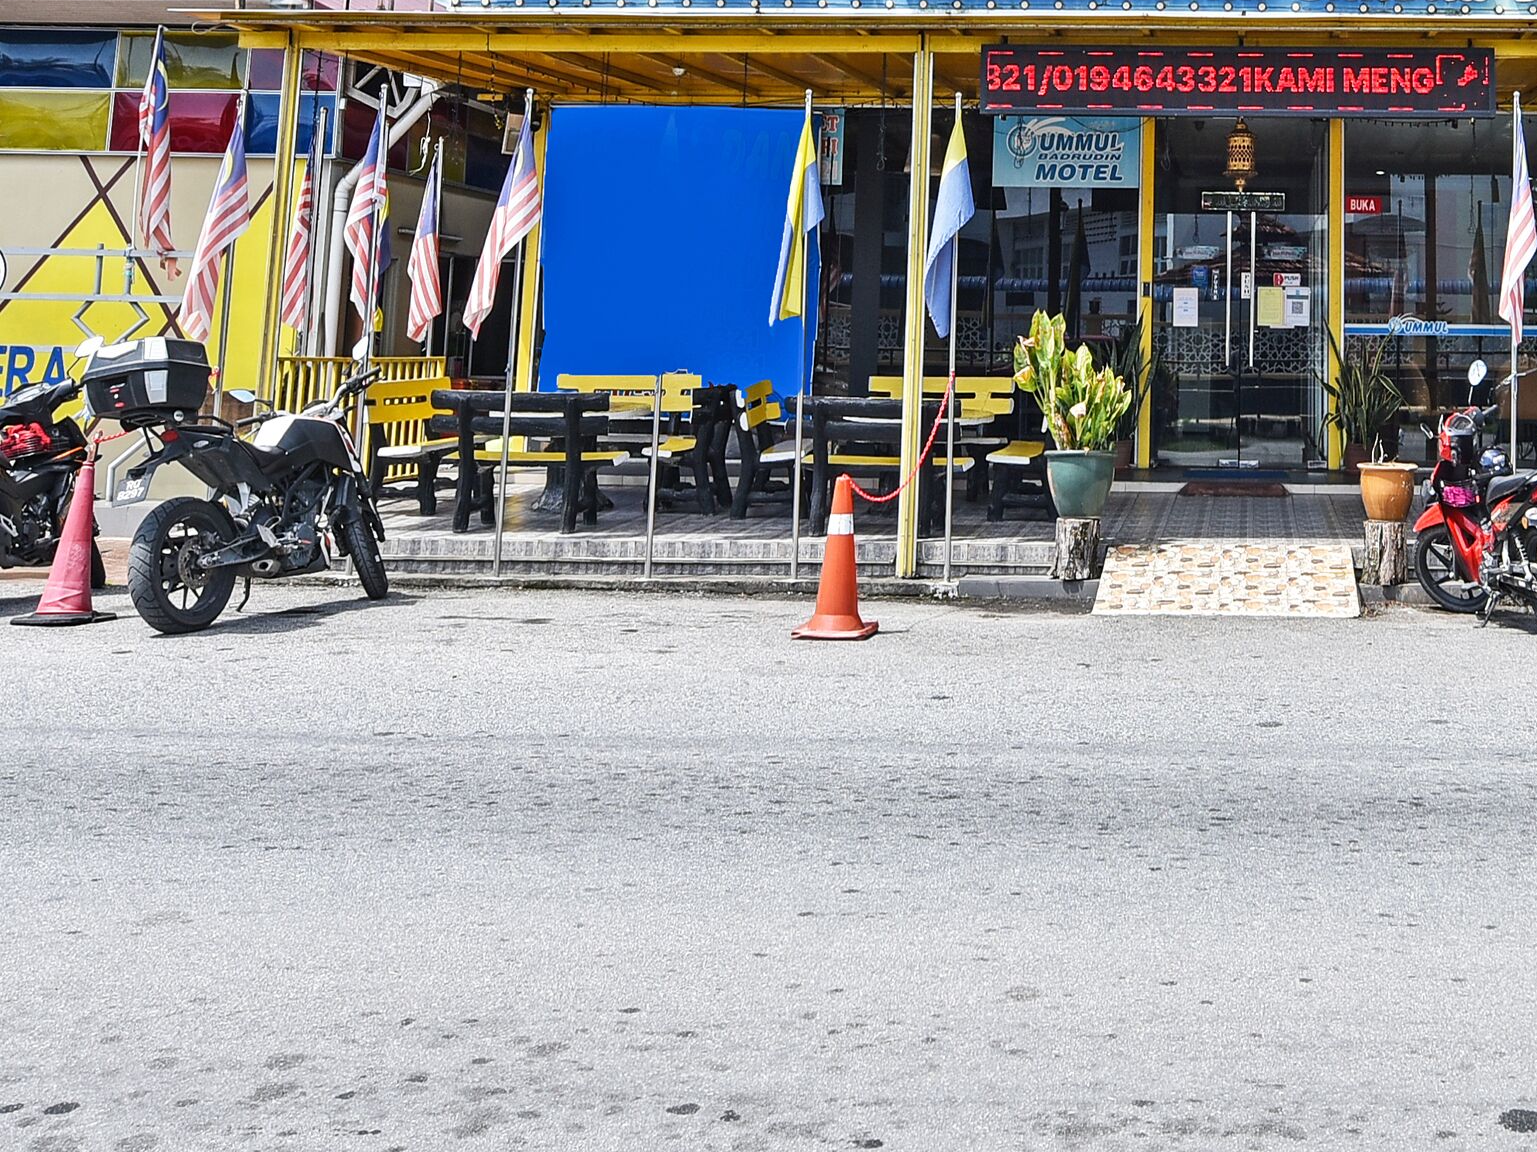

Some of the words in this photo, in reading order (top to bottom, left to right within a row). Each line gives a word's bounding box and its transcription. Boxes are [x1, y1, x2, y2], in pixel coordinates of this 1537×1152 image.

[1039, 133, 1123, 152] UMMUL
[1037, 152, 1122, 161] BADRUDIN
[1035, 163, 1123, 181] MOTEL
[1350, 199, 1376, 211] BUKA
[1404, 321, 1448, 333] UMMUL
